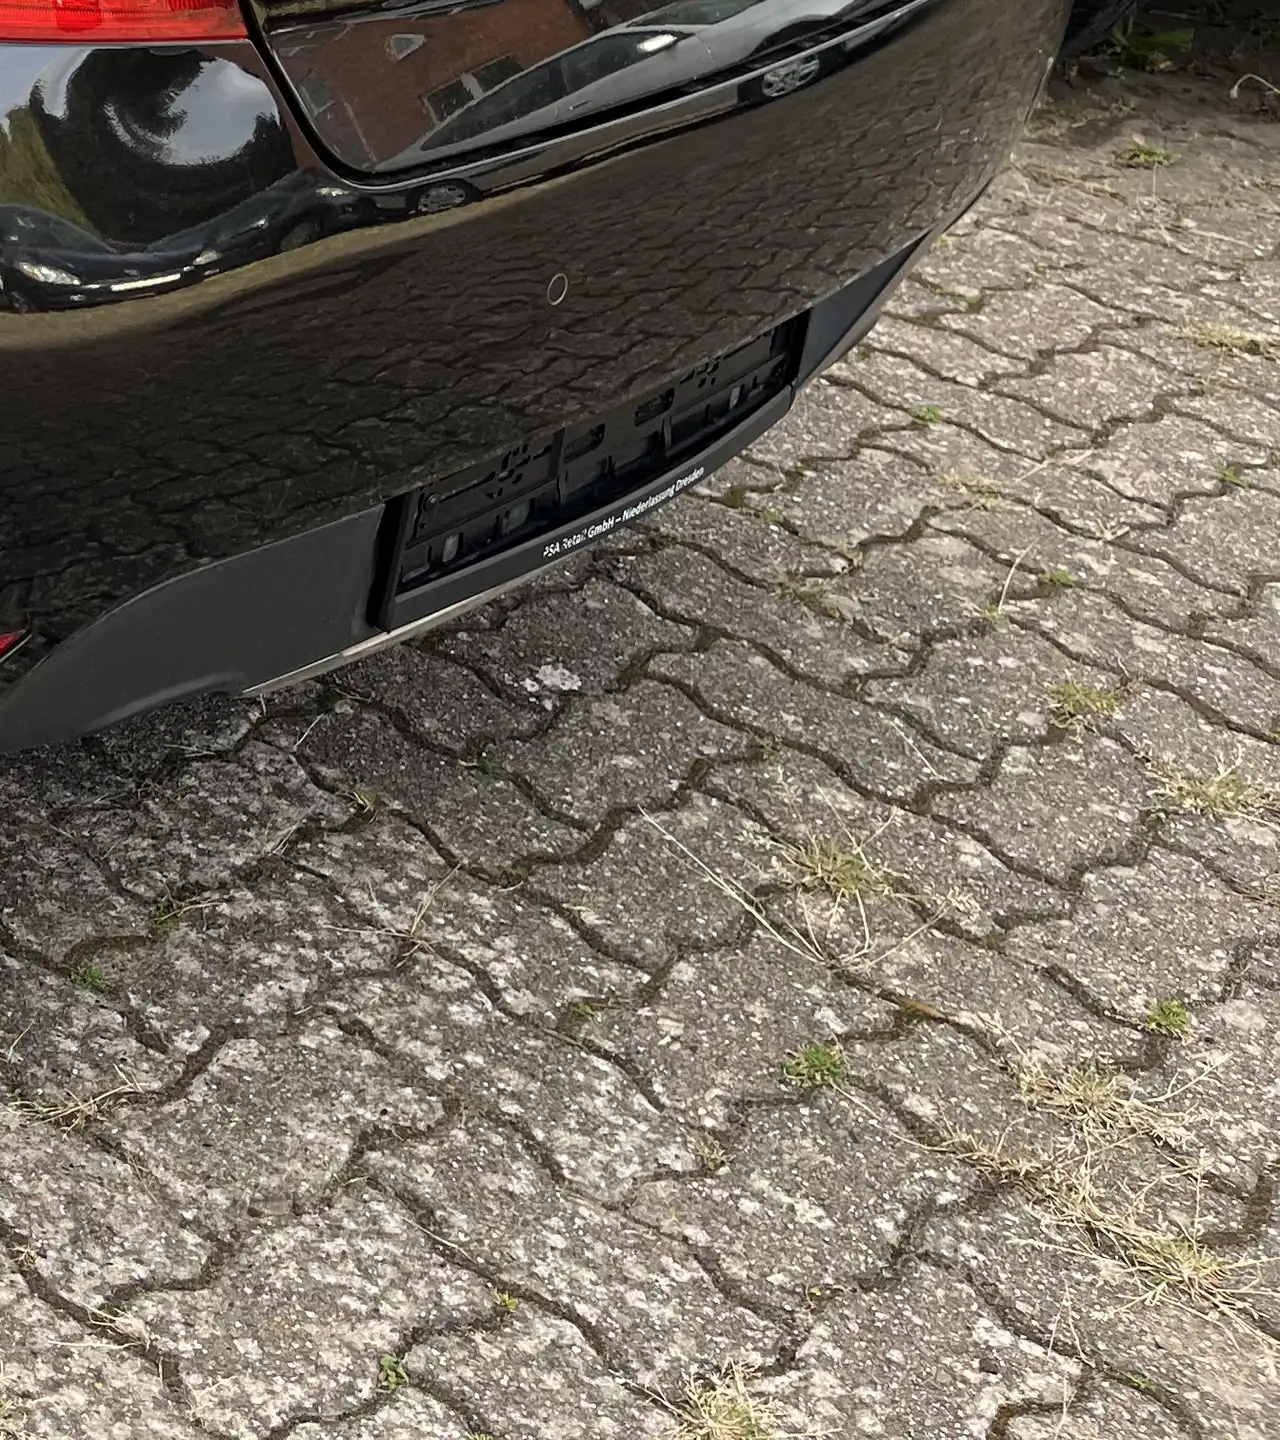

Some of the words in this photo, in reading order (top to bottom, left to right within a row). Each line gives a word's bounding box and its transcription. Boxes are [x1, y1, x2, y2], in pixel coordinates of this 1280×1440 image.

[542, 541, 561, 558] PSA
[587, 515, 616, 539] GmbH
[622, 484, 676, 522] Niederlassung
[675, 466, 705, 491] Dresden
